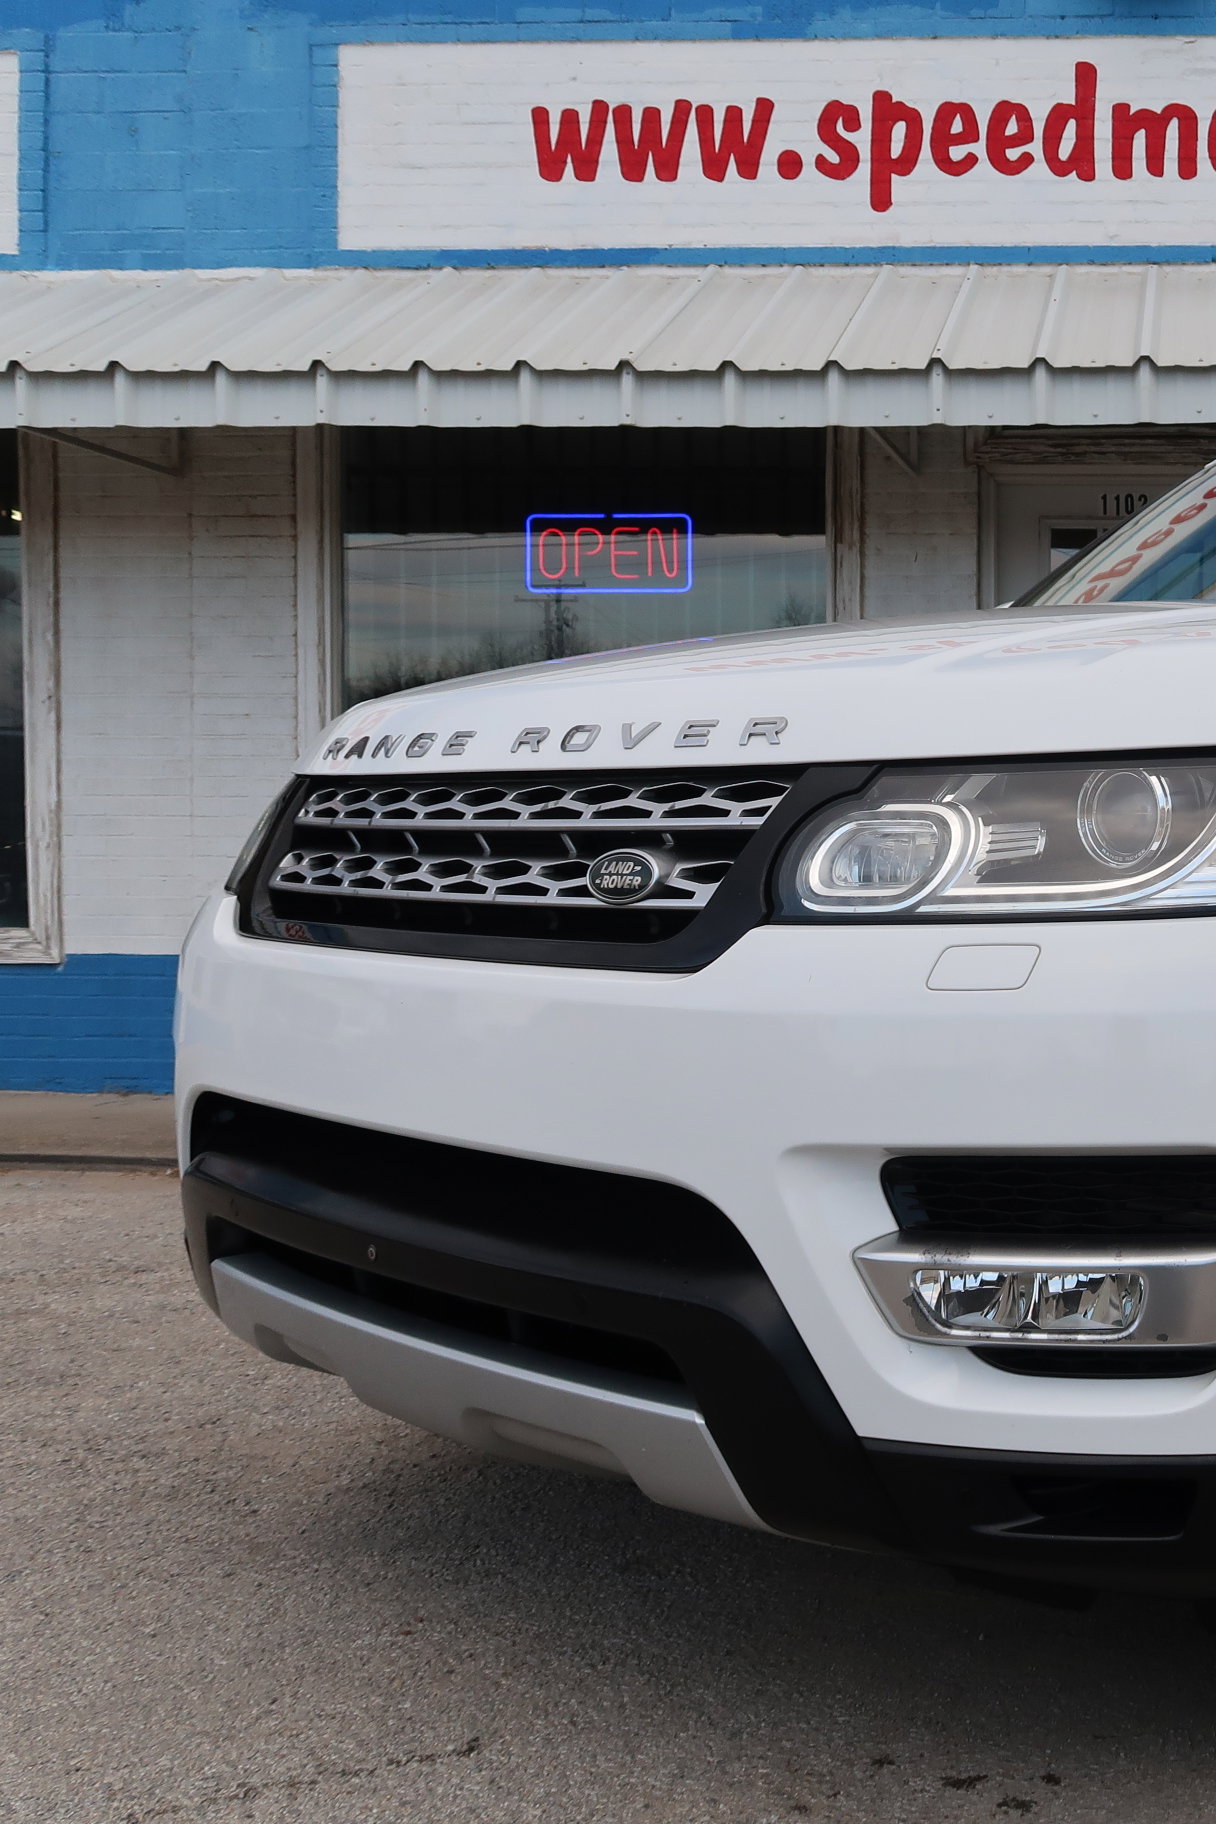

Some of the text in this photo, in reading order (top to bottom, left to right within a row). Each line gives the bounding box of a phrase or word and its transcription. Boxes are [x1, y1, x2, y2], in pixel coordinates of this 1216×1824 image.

[538, 527, 679, 579] OPEN
[322, 716, 788, 761] RANGE ROVER
[600, 861, 634, 874] LAND
[600, 875, 642, 889] ROVER
